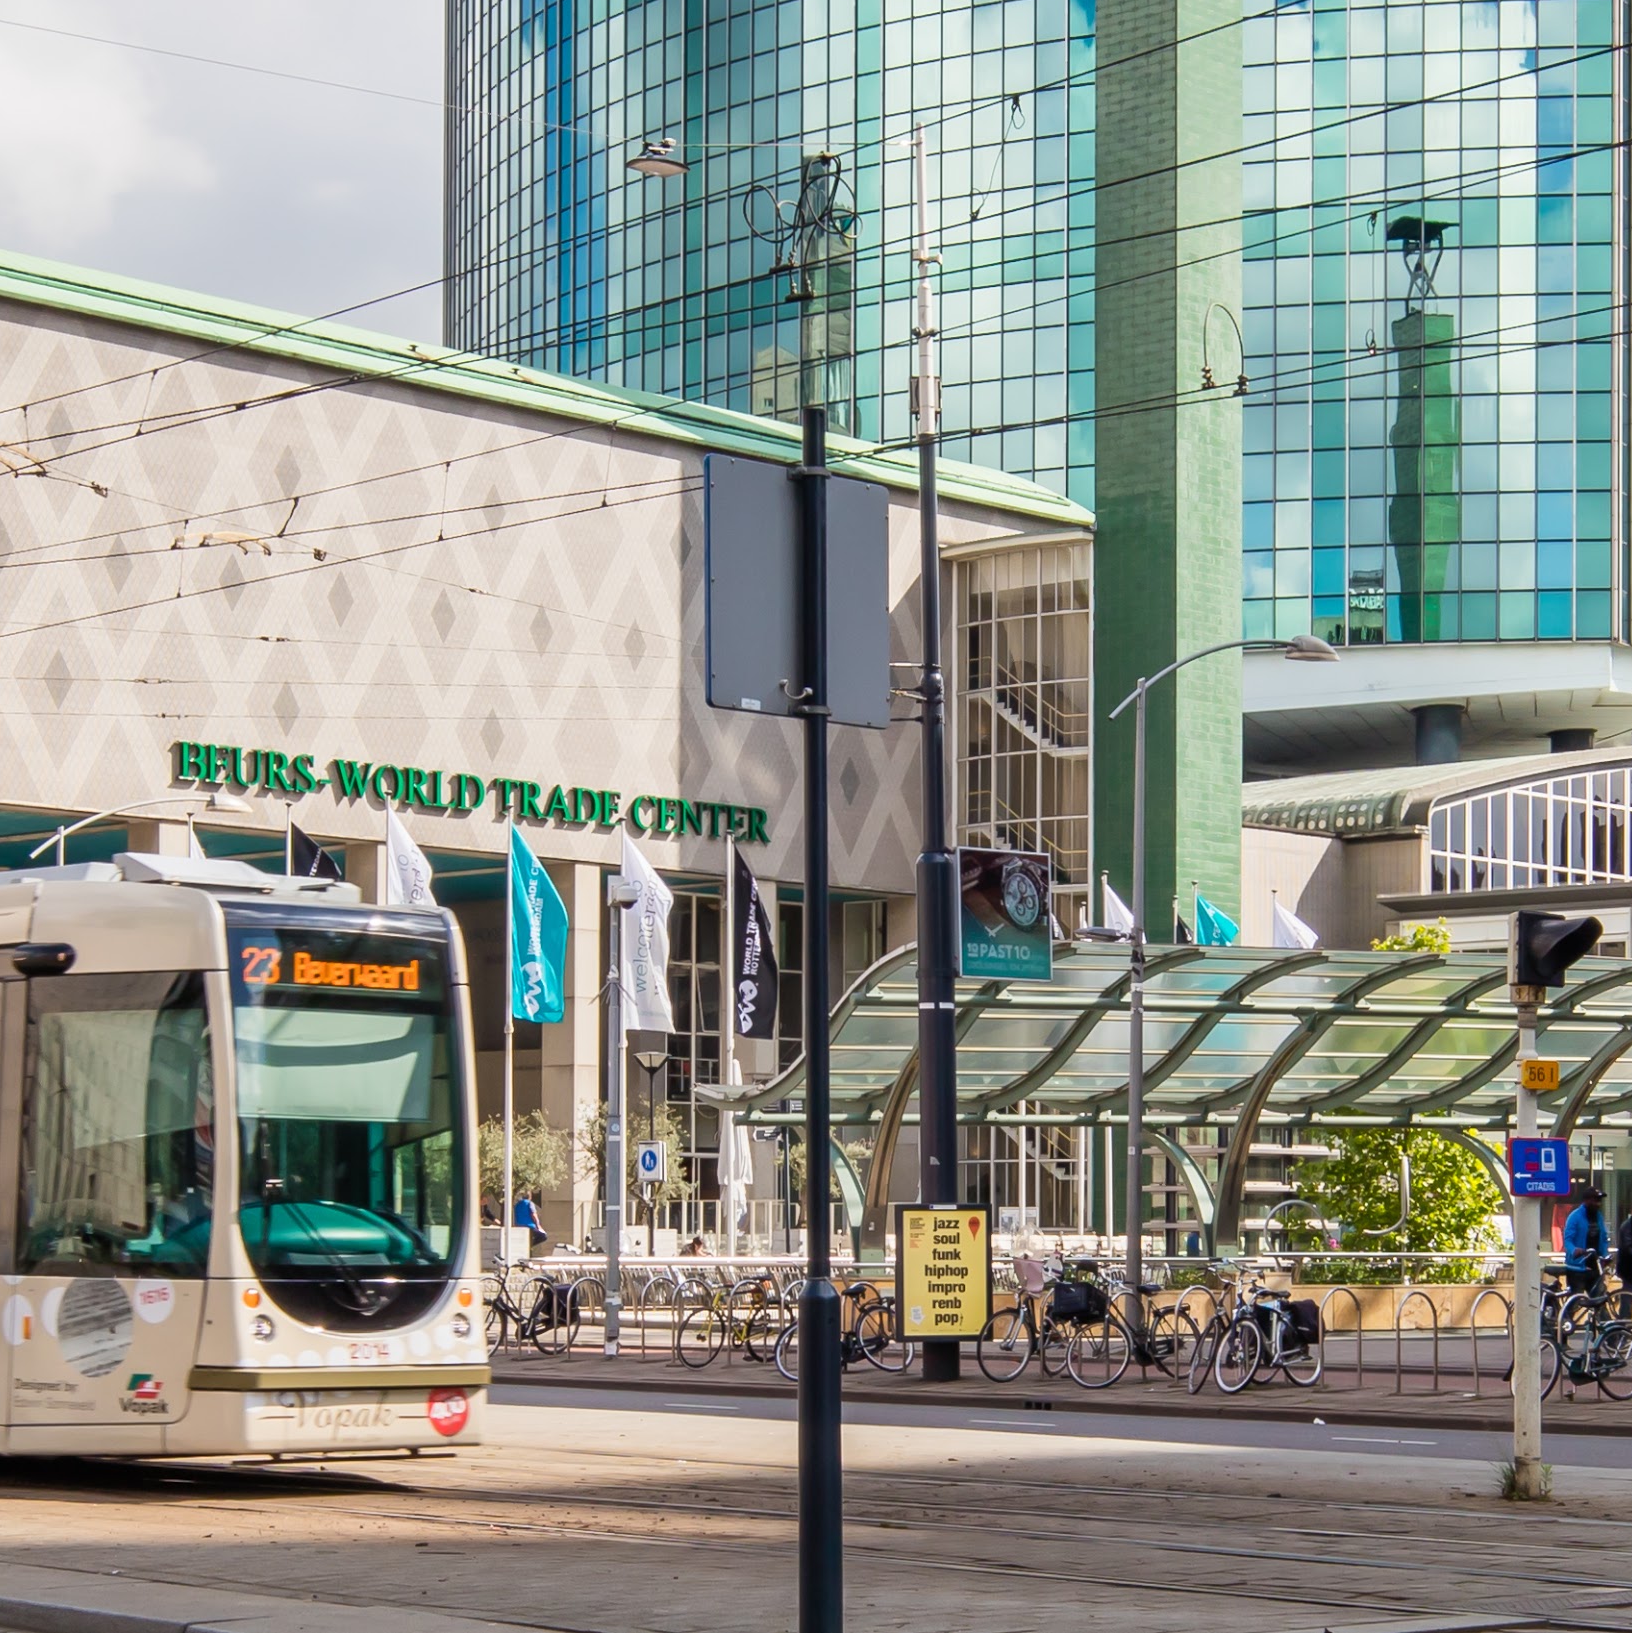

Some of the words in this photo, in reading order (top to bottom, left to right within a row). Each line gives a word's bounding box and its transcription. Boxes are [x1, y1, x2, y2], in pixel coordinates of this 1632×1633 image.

[176, 739, 485, 811] BEURS-WORLD
[496, 777, 621, 826] TRADE
[630, 794, 771, 844] CENTER
[742, 938, 754, 975] WORLD
[241, 946, 281, 985] 23
[1592, 1151, 1614, 1171] WE
[1526, 1182, 1555, 1192] CITADIS
[933, 1217, 959, 1232] jazz
[933, 1233, 960, 1245] soul
[932, 1248, 961, 1260] funk
[924, 1264, 968, 1279] hiphop
[928, 1281, 966, 1295] impro
[932, 1297, 961, 1309] renb
[935, 1313, 959, 1325] pop
[118, 1397, 170, 1416] Vopak
